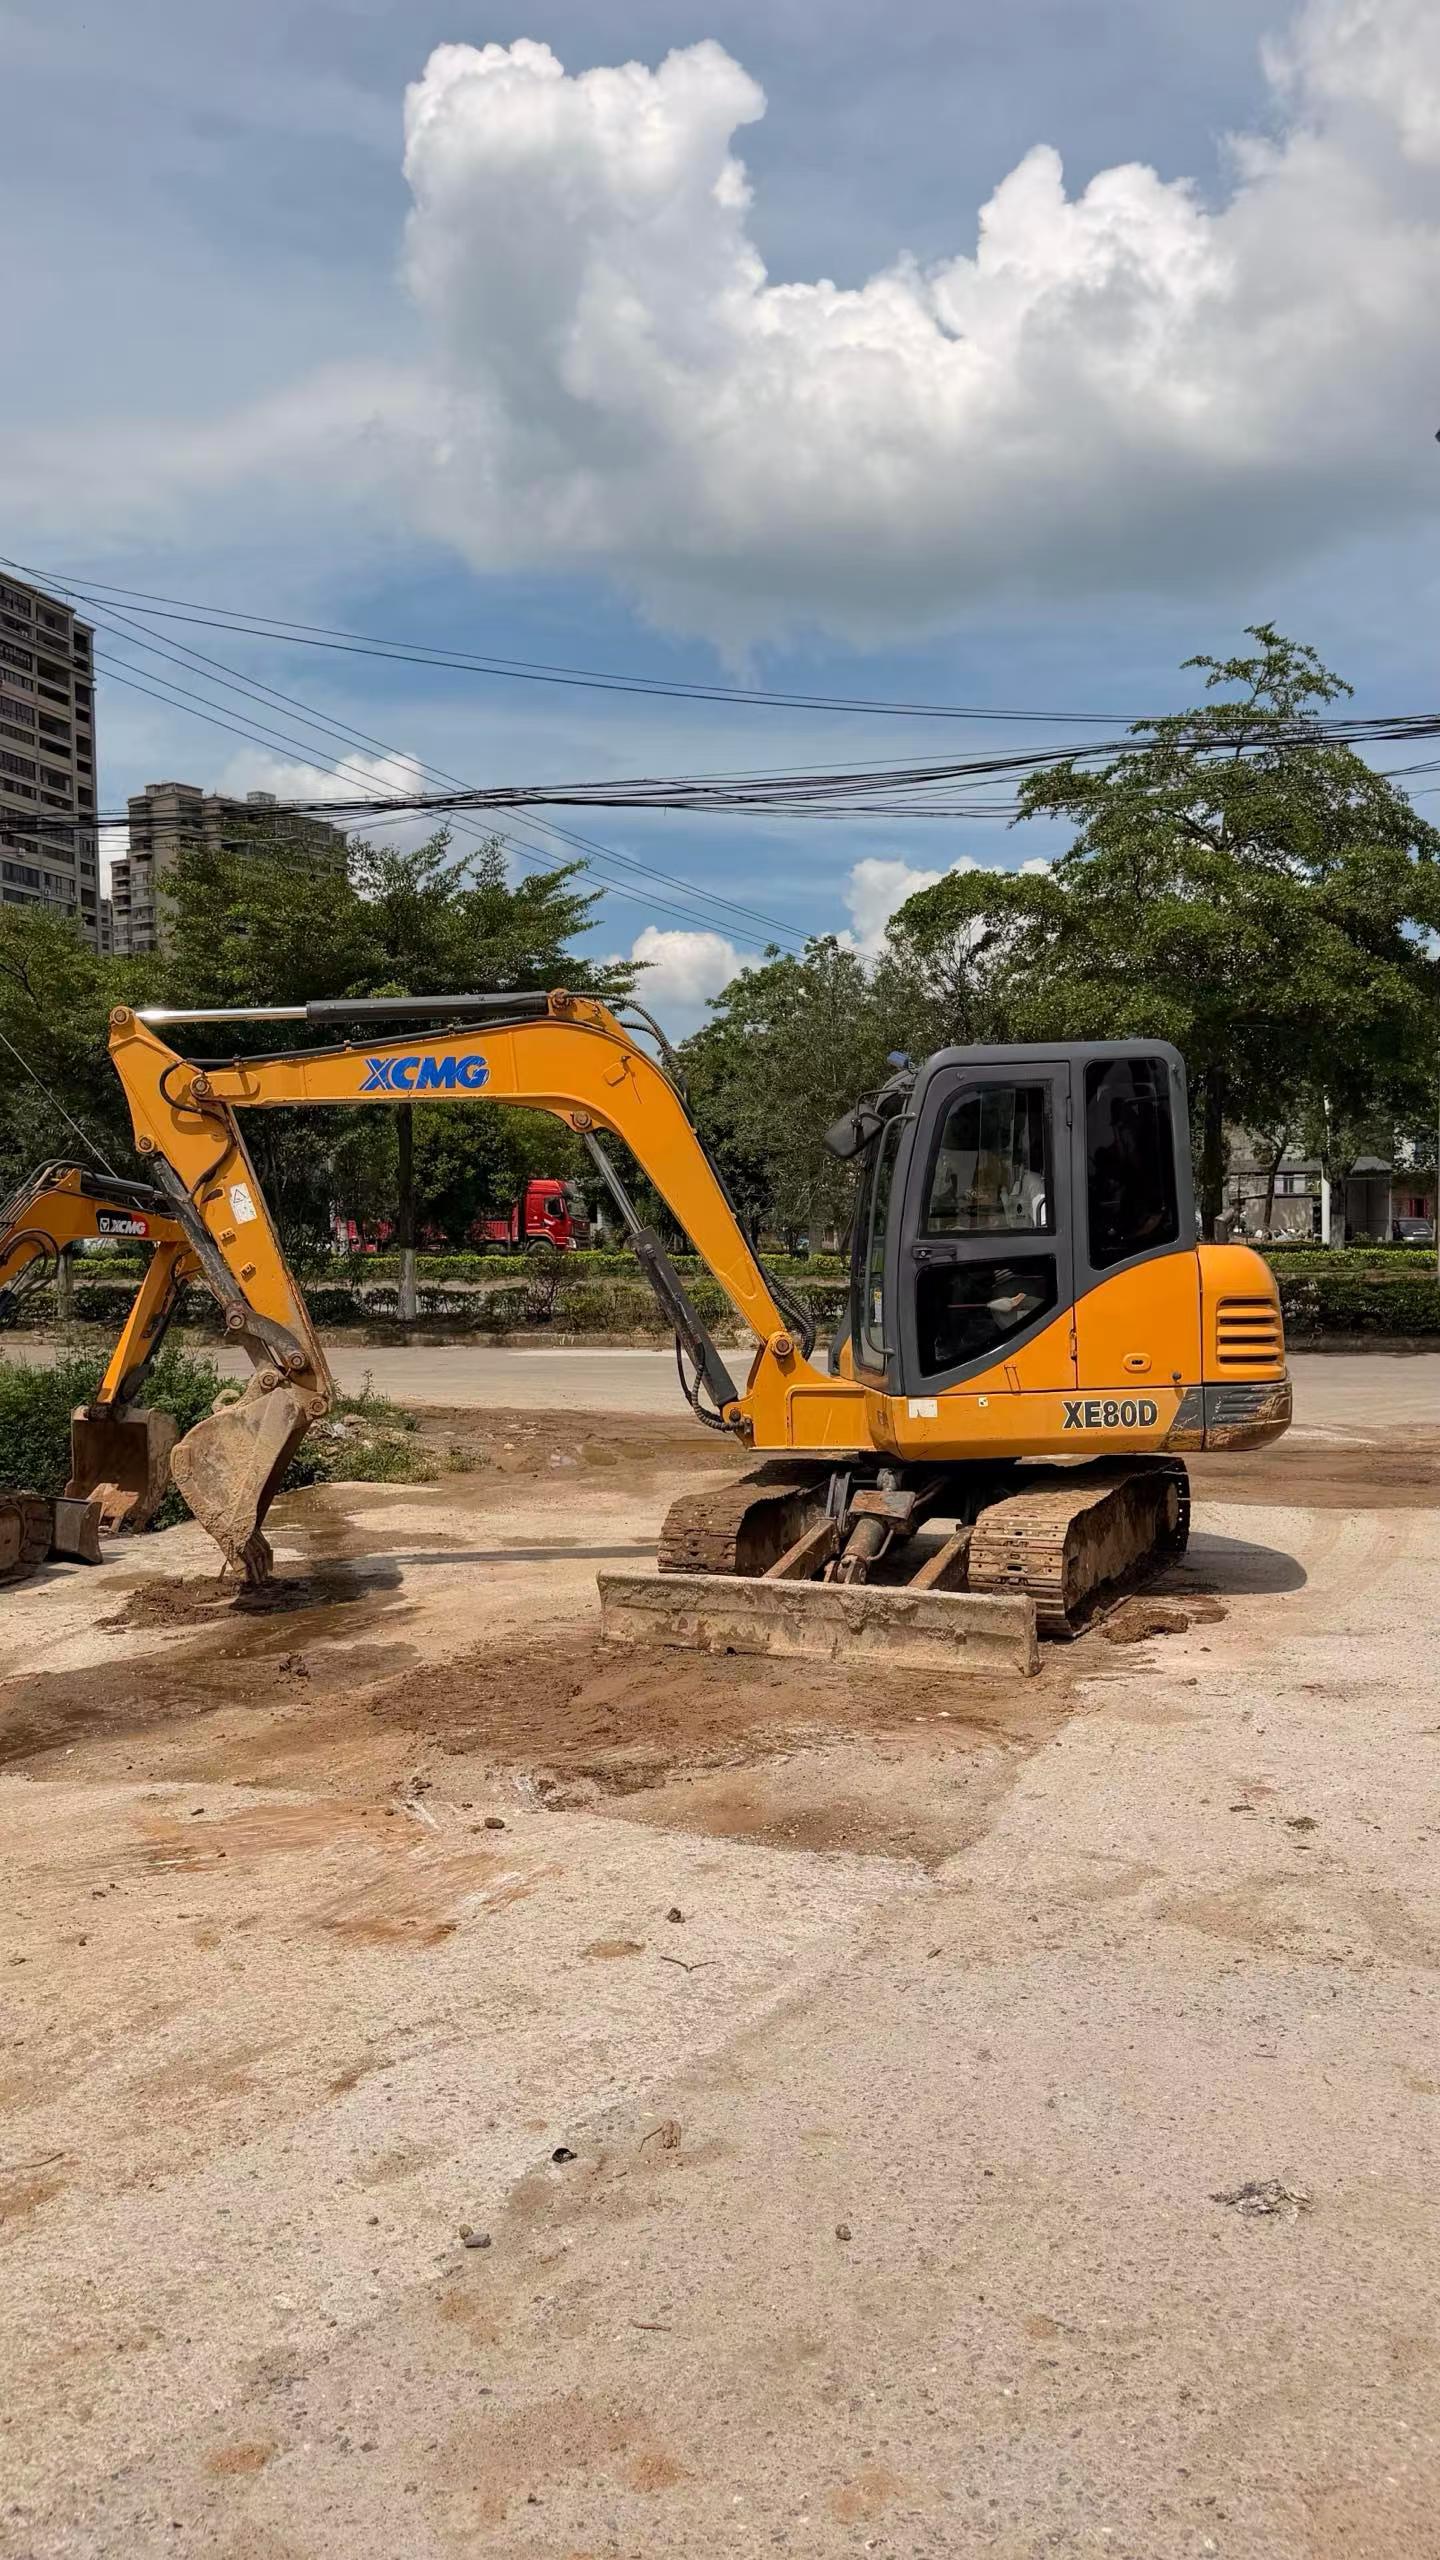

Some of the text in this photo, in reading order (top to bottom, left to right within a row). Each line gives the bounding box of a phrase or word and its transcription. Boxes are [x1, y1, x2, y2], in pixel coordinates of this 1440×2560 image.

[359, 1056, 489, 1090] XCMG
[110, 1219, 146, 1235] XCMG
[1062, 1399, 1158, 1429] XE80D
